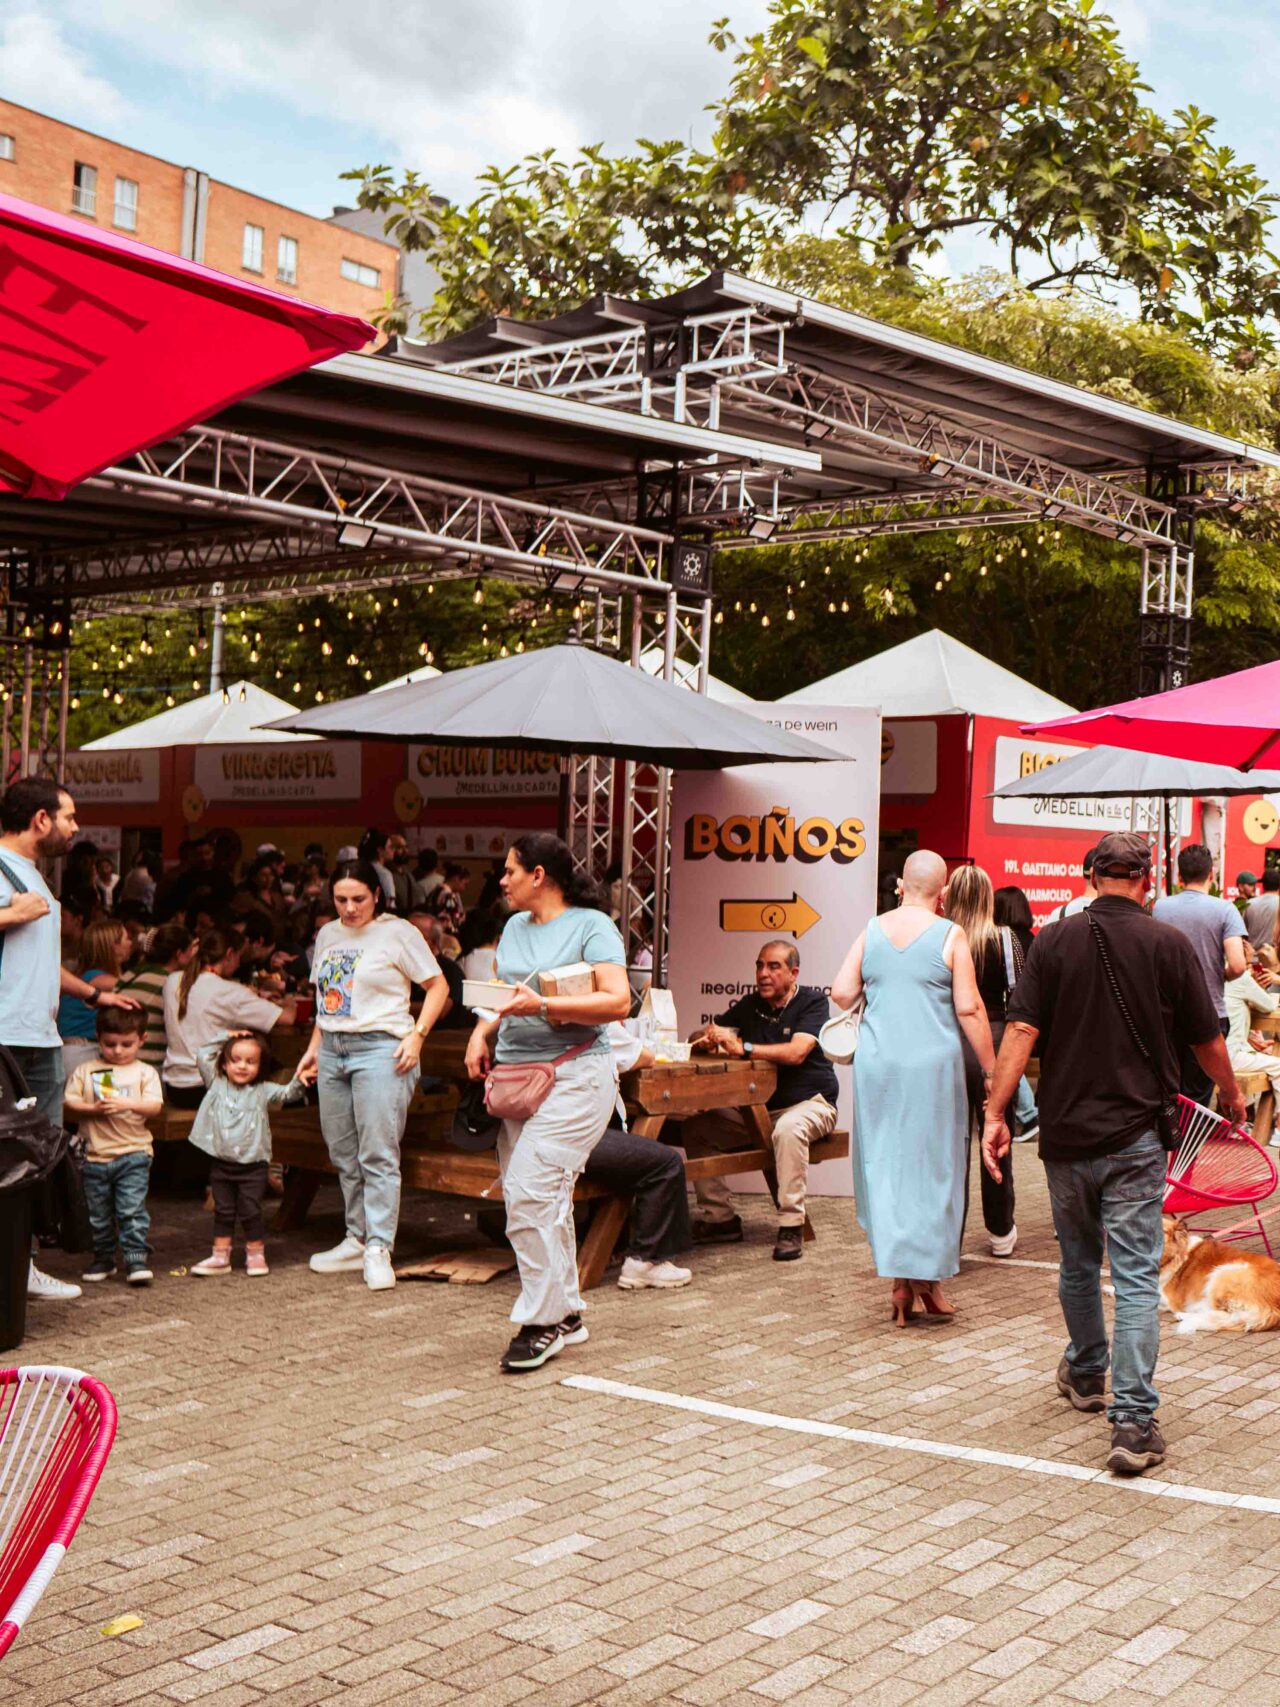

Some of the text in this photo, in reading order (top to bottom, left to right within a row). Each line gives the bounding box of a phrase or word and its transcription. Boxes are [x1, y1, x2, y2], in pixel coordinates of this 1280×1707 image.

[417, 747, 489, 777] CHUM
[1033, 798, 1105, 819] MEDELLÍN
[1021, 861, 1068, 878] GAETTANO
